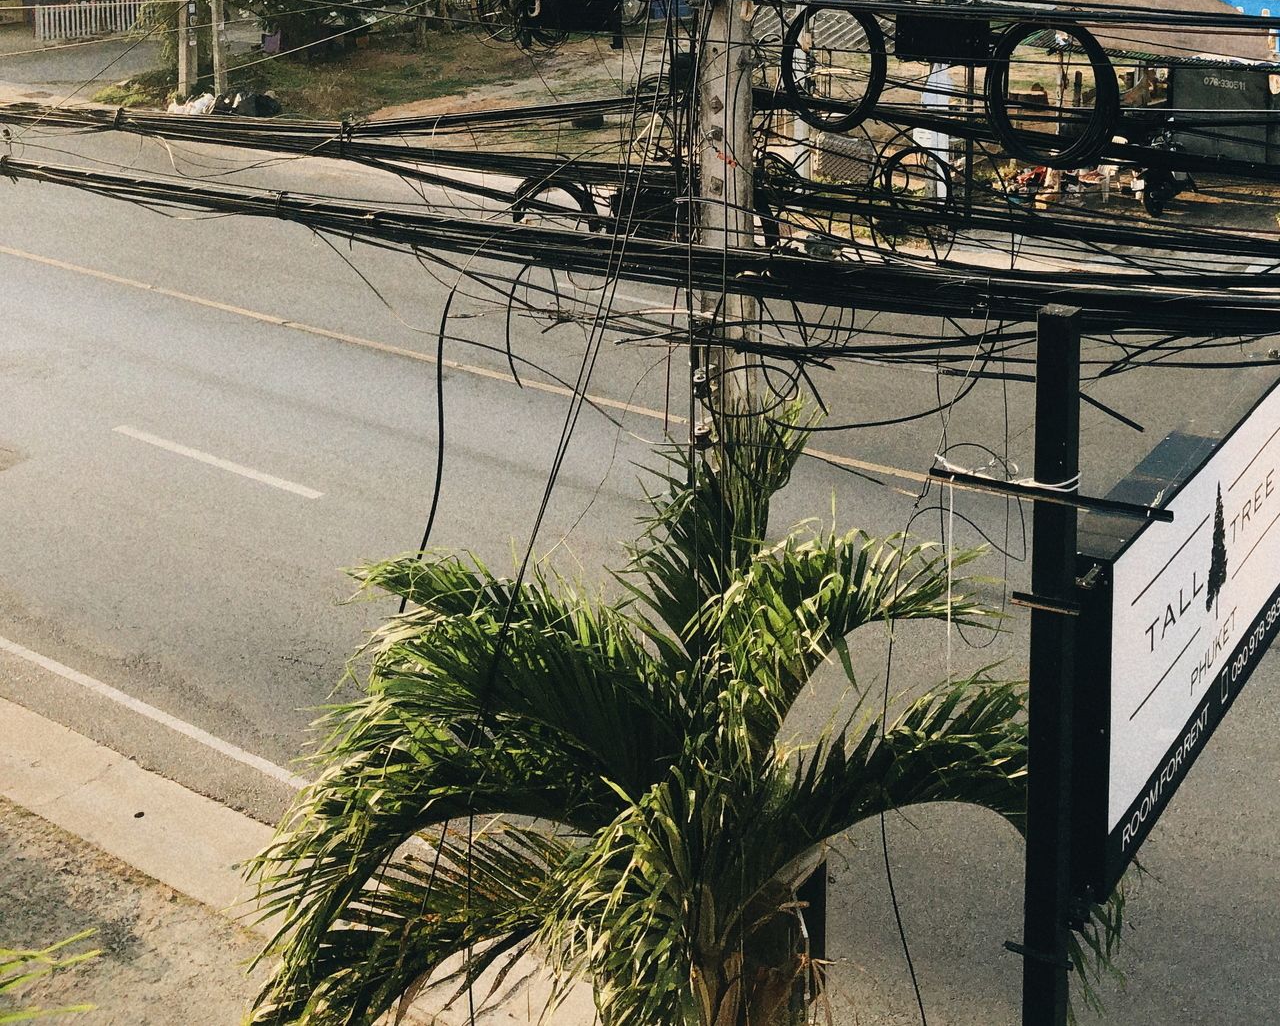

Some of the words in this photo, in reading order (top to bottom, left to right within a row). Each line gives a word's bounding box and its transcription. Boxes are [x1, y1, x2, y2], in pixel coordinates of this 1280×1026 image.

[1145, 582, 1204, 654] TALL
[1230, 468, 1276, 545] TREE
[1190, 605, 1238, 697] PHUKET
[1121, 779, 1159, 853] ROOM
[1159, 745, 1183, 795] FOR
[1183, 702, 1210, 758] RENT
[1231, 645, 1249, 682] 090
[1248, 620, 1265, 656] 978
